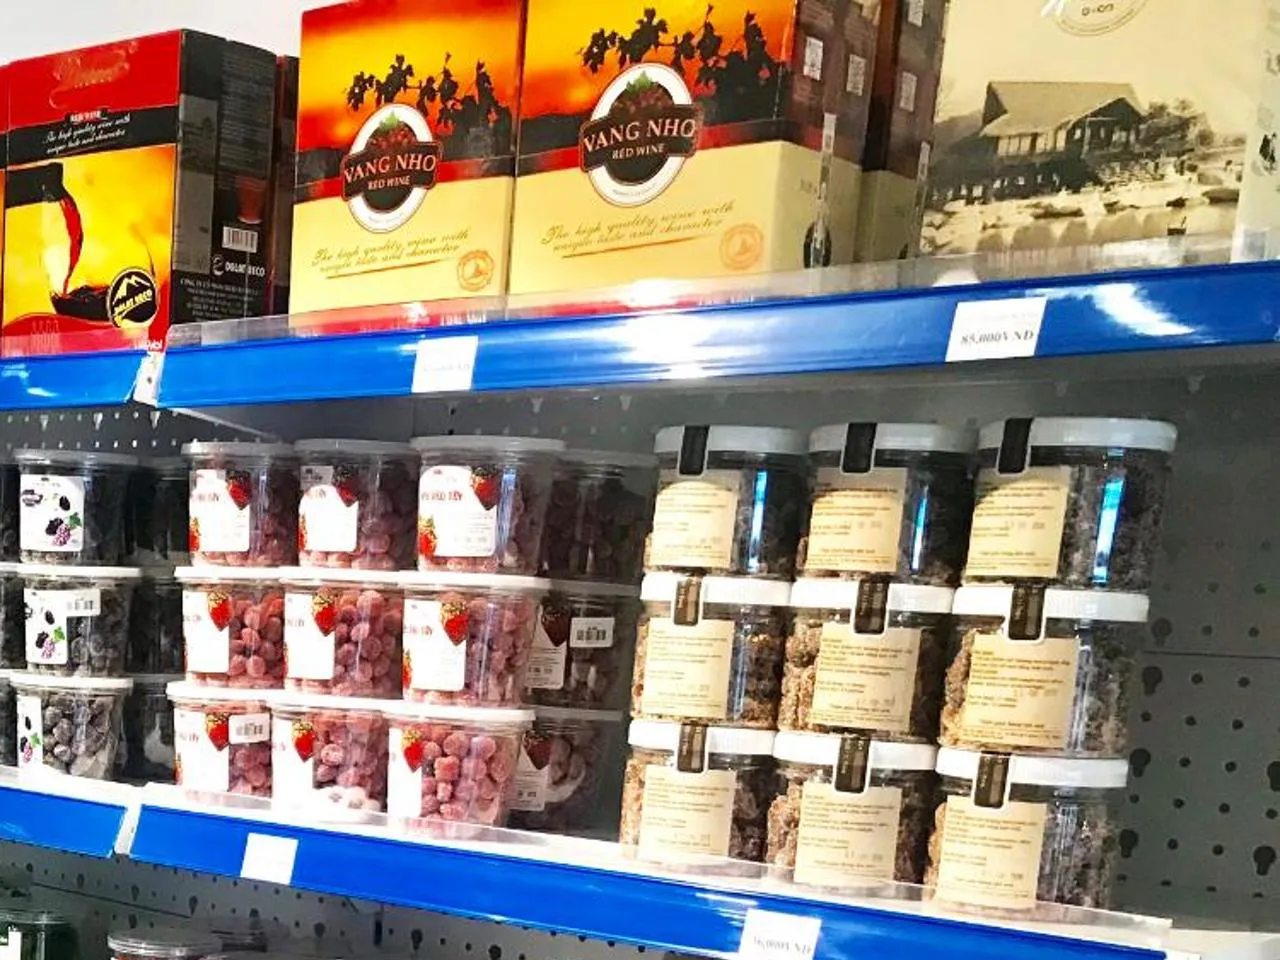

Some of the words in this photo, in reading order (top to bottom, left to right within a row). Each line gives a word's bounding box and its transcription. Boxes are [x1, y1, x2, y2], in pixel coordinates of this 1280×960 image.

[583, 120, 641, 153] VANG
[645, 117, 697, 139] NHO
[612, 147, 634, 161] RED
[635, 143, 666, 157] WINE
[343, 156, 391, 184] VANG
[395, 153, 437, 172] NHO
[367, 178, 386, 191] RED
[386, 175, 411, 188] WINE
